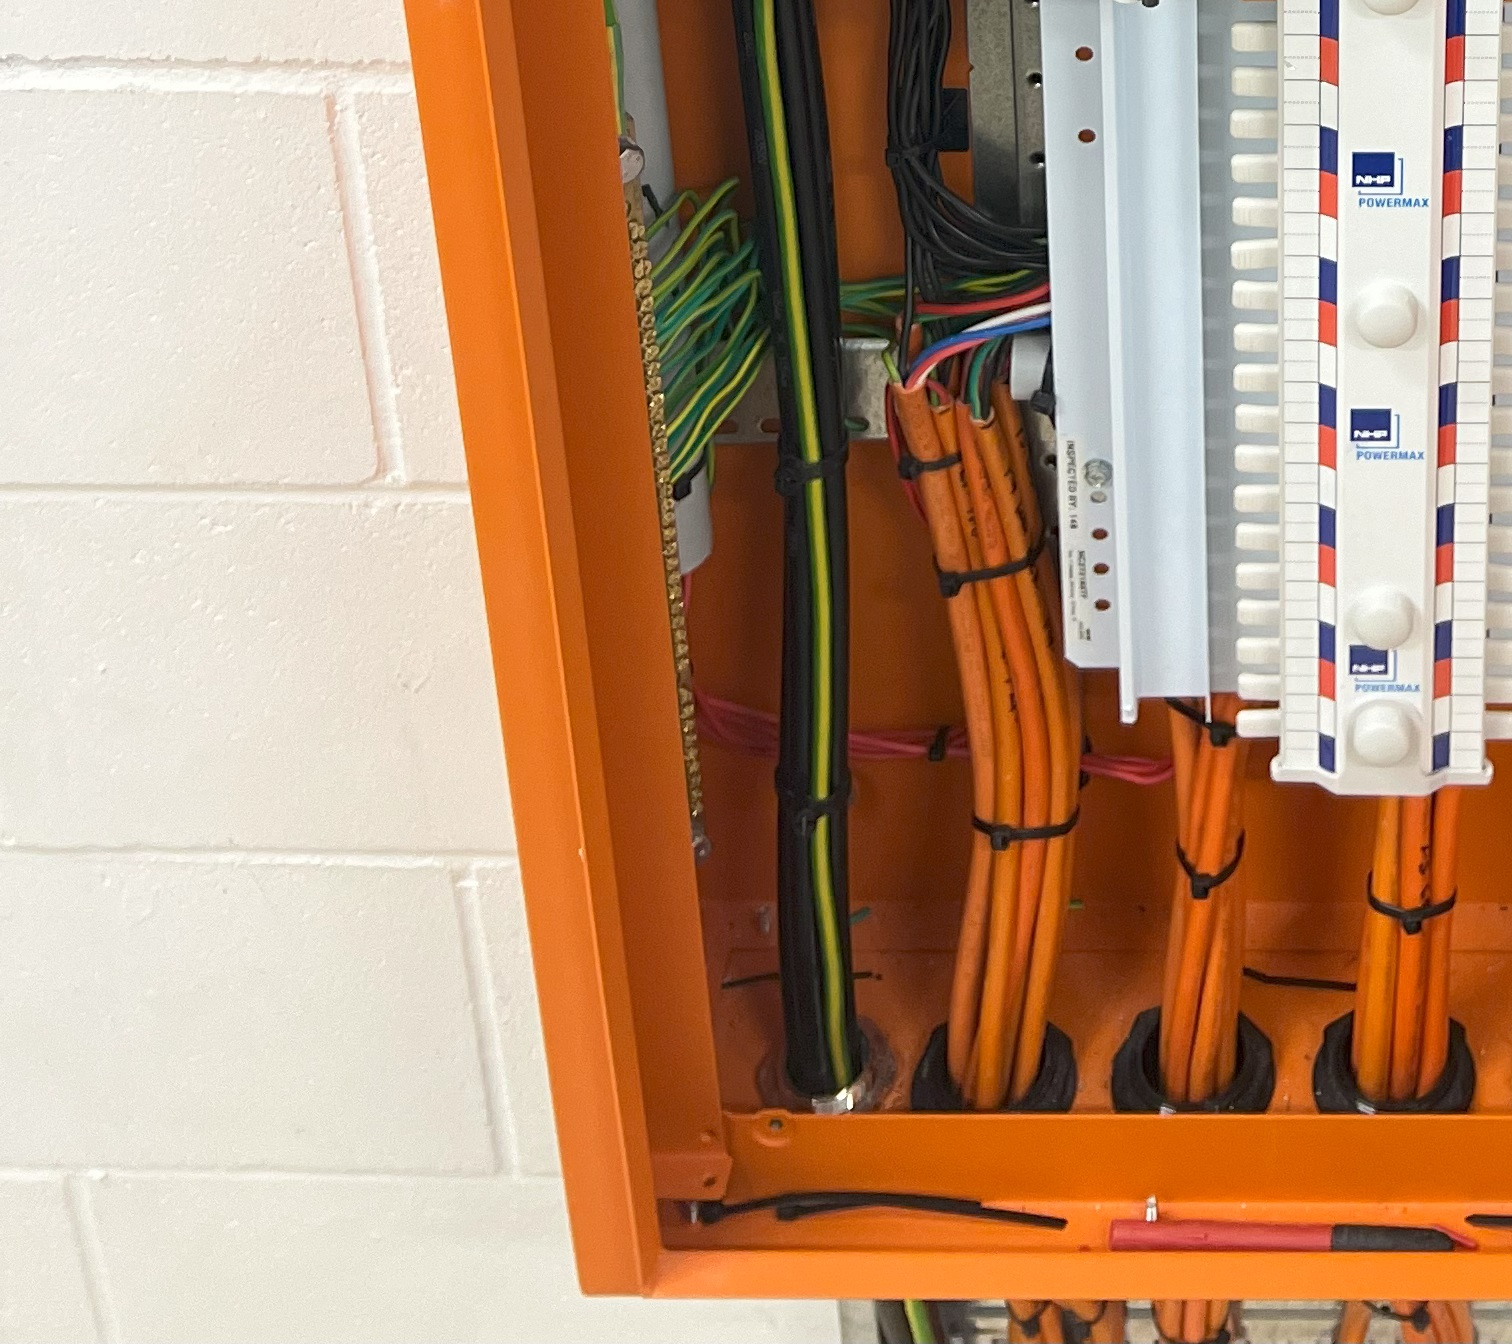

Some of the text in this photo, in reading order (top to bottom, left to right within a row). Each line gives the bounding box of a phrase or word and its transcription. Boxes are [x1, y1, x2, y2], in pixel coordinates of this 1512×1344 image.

[1358, 197, 1430, 209] POWERMAX
[1356, 449, 1426, 461] POWERMAX
[1355, 682, 1421, 693] POWERMAX
